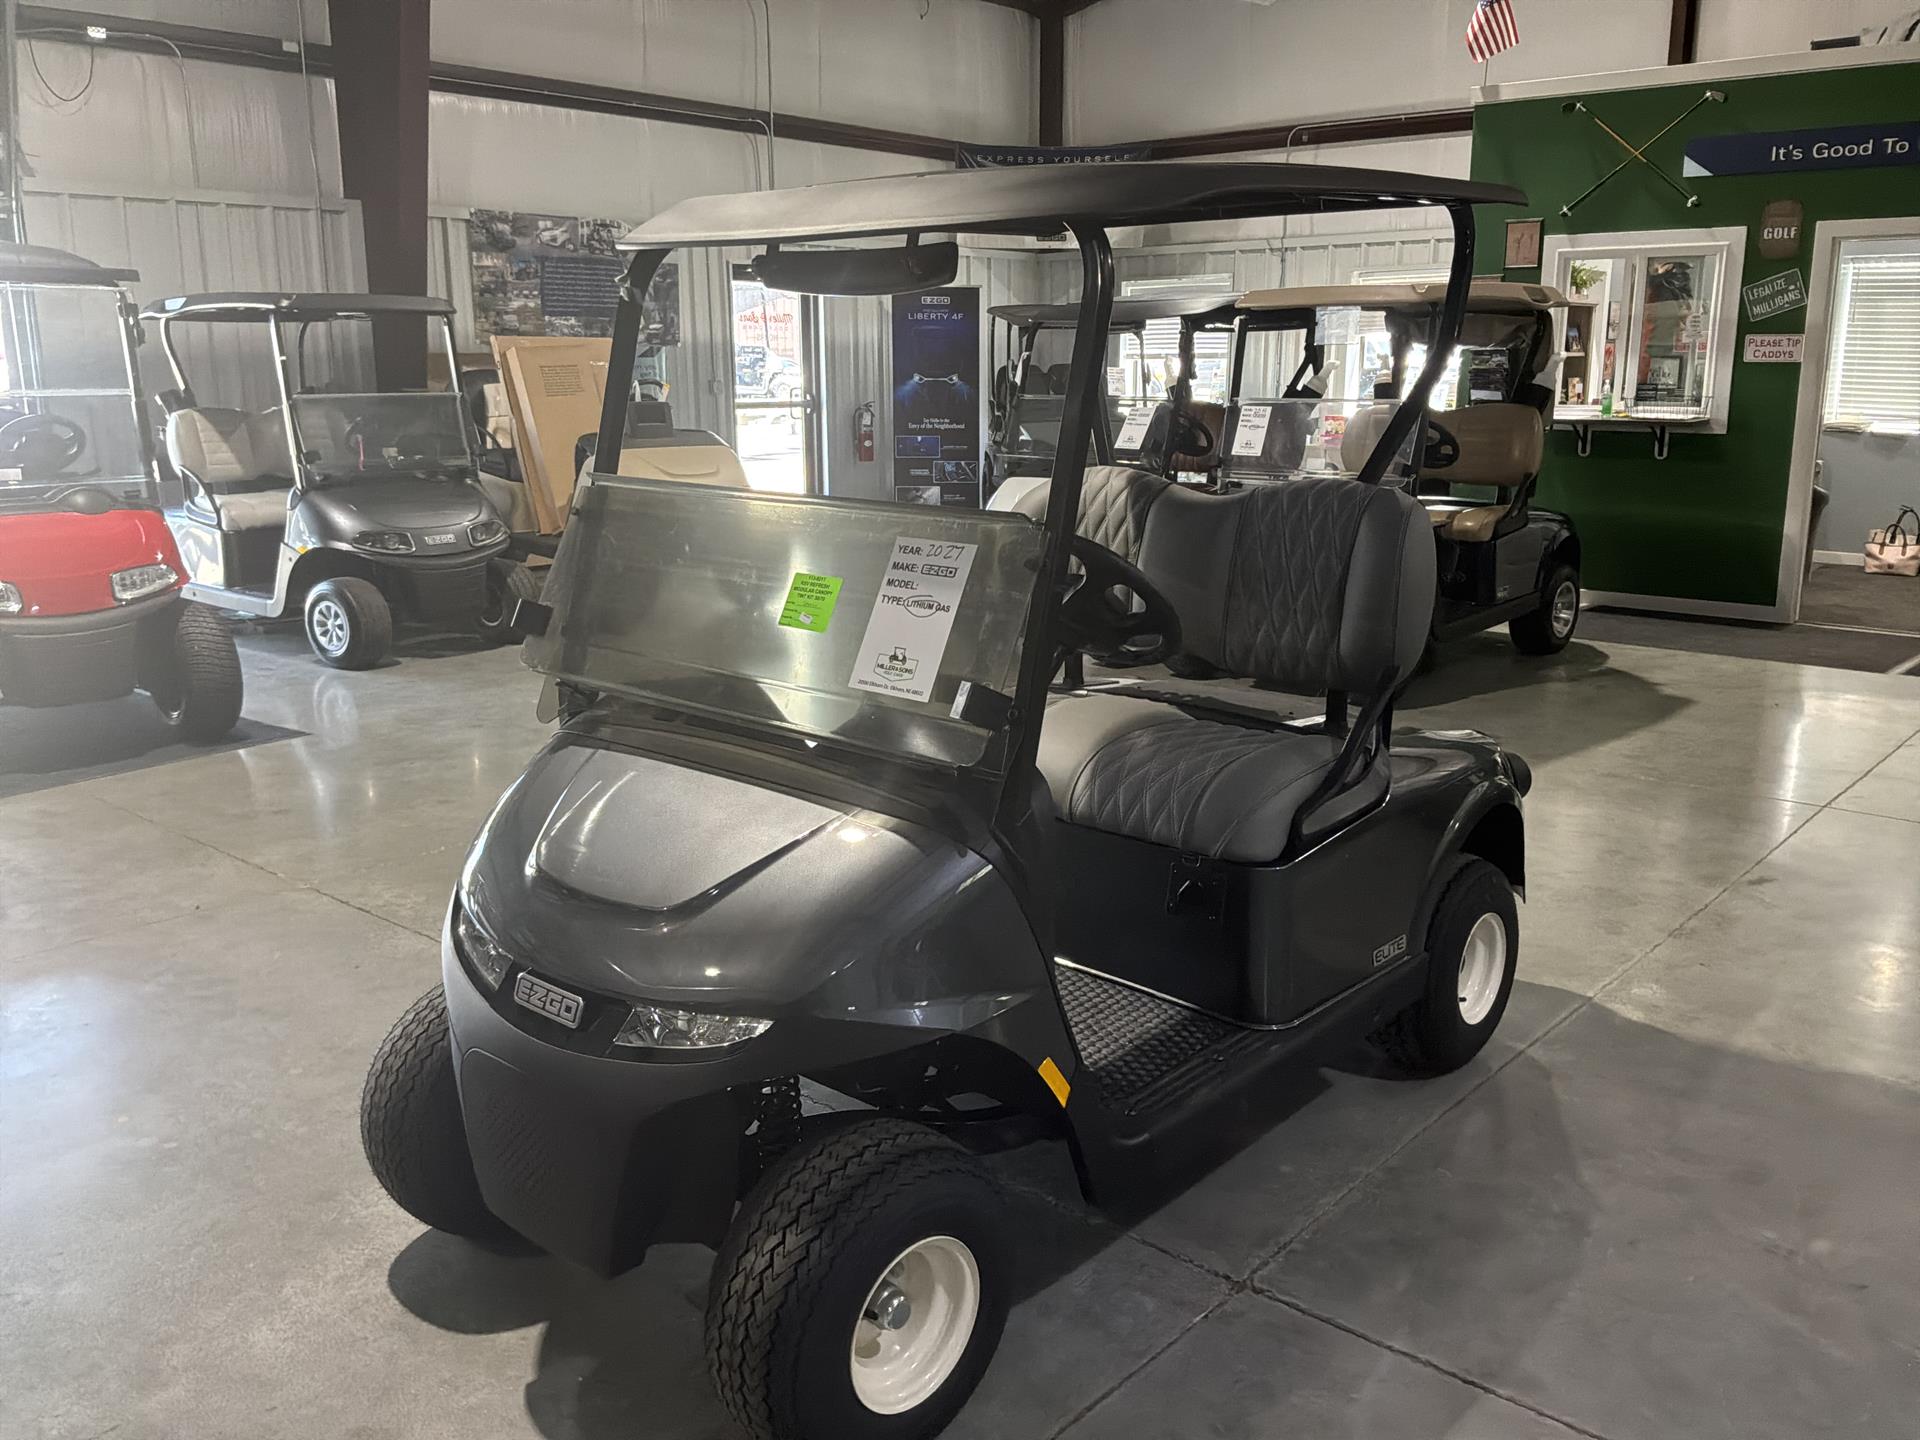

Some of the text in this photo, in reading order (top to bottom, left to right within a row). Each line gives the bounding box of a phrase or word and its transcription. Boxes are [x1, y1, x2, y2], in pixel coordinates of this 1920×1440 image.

[1770, 137, 1910, 162] It's Good To
[976, 153, 1132, 164] EXPRESS YOURSELF
[1762, 226, 1798, 240] GOLF
[1748, 277, 1788, 300] LEGALIZE
[921, 296, 951, 305] EZGO
[1752, 289, 1802, 316] MULLIGANS
[907, 312, 964, 320] LIBERTY 4F
[1748, 337, 1801, 348] PLEASE TIP
[1752, 349, 1794, 359] CADDYS
[898, 544, 922, 556] YEAR:
[891, 561, 958, 578] MAKE: EZGO
[886, 578, 919, 590] MODEL:
[881, 594, 951, 613] TYPE: LITHIUM GAS
[1374, 936, 1406, 965] ELITE
[516, 977, 580, 1025] EZGO
